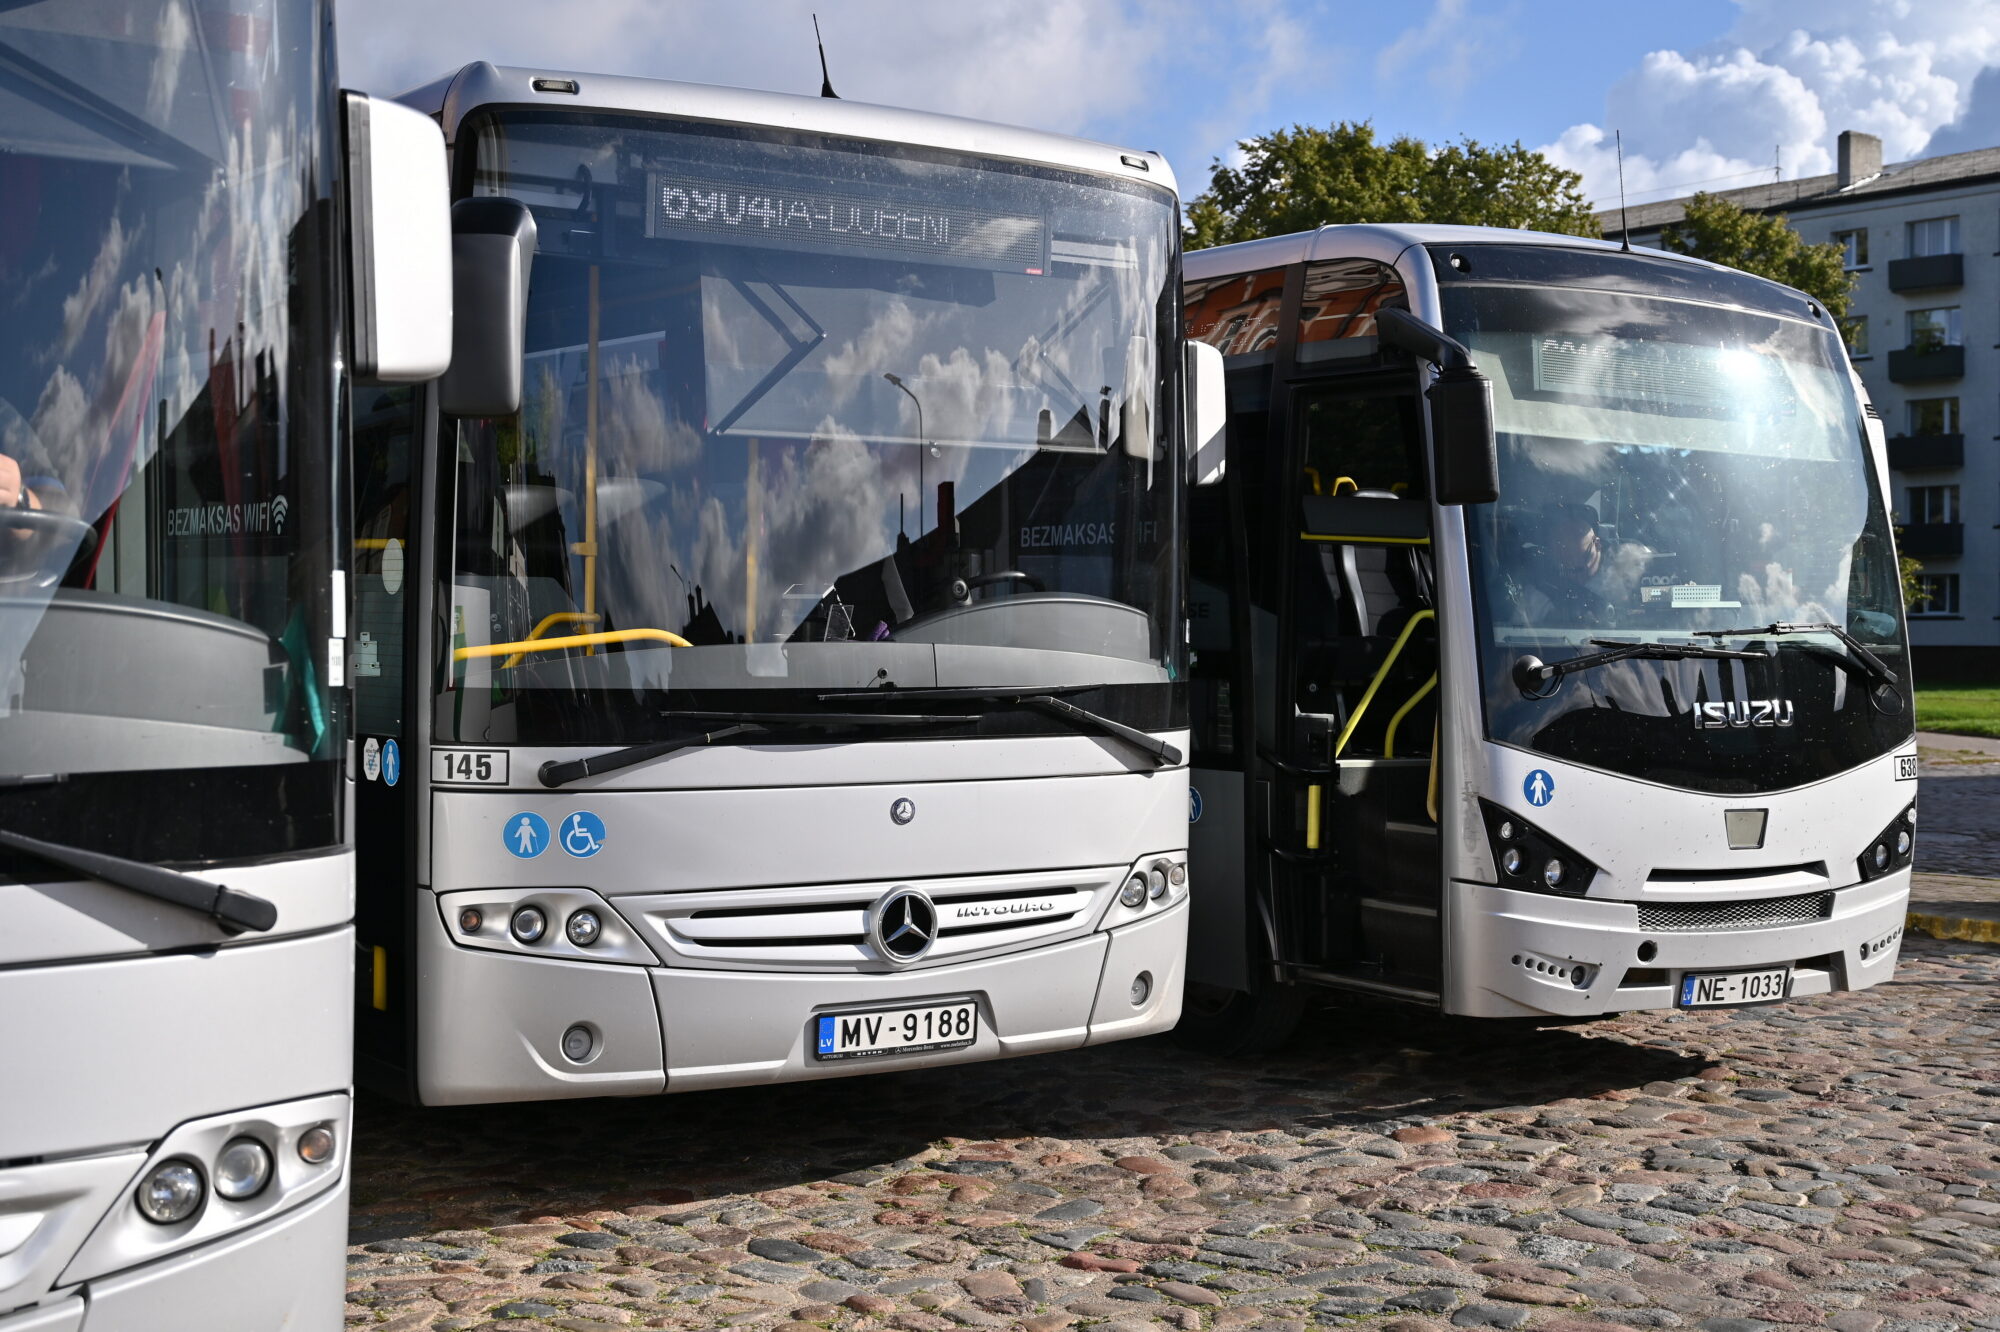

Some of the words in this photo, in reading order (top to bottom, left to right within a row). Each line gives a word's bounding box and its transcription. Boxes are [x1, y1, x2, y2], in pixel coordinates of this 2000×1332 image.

[167, 504, 241, 536] BEZMAKSAS
[243, 501, 271, 532] WIFI
[1693, 698, 1794, 729] ISUZU
[444, 753, 492, 781] 145
[1900, 757, 1917, 778] 638
[1696, 973, 1782, 1003] NE-1033
[820, 1038, 833, 1048] LV
[841, 1007, 970, 1048] MV-9188
